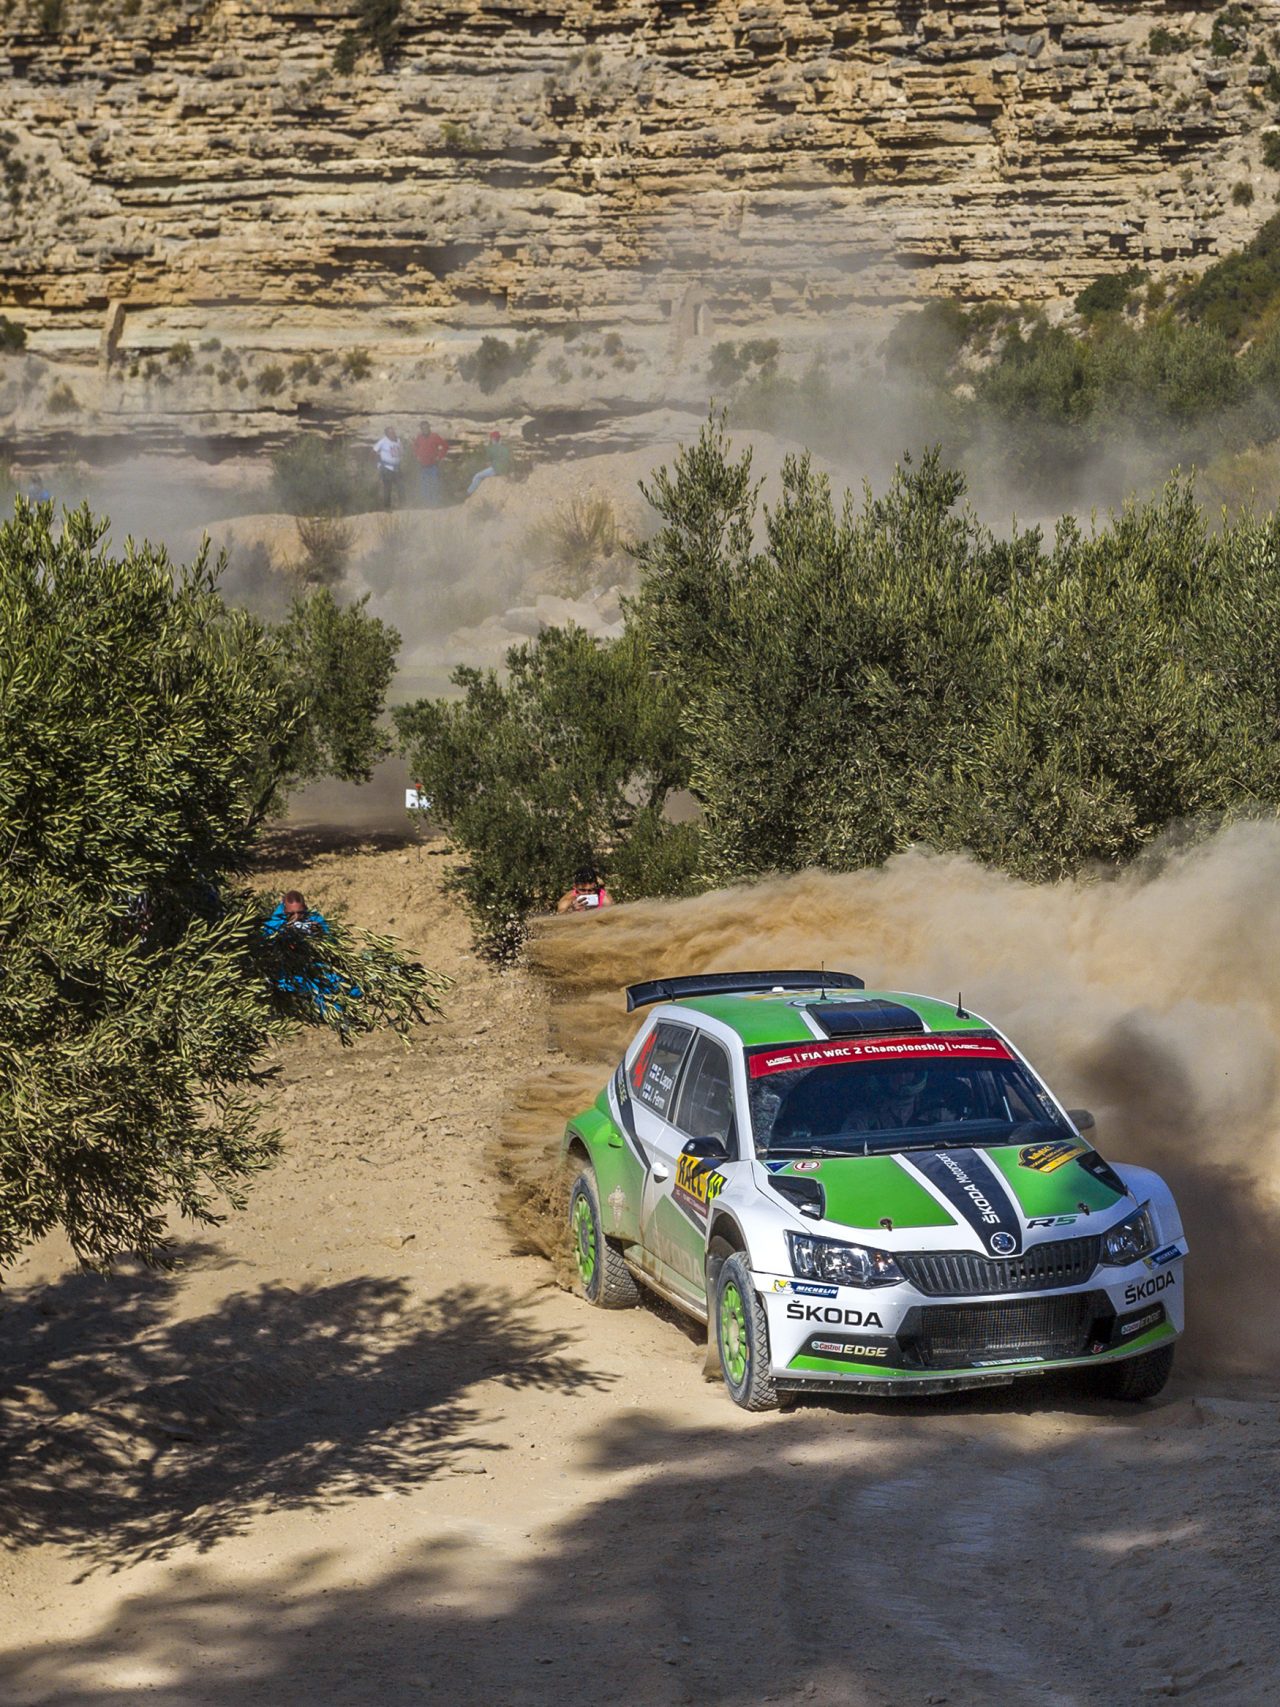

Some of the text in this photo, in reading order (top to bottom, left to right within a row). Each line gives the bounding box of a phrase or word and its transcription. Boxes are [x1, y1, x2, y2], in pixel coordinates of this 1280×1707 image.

[801, 1043, 945, 1061] FIA WRC 2 Championship
[935, 1153, 1001, 1224] ŠKODA Motorsport
[1027, 1216, 1078, 1229] R5
[796, 1285, 838, 1295] MICHELIN
[1124, 1270, 1176, 1305] ŠKODA
[786, 1300, 884, 1329] ŠKODA
[819, 1342, 889, 1358] Castrol EDGE
